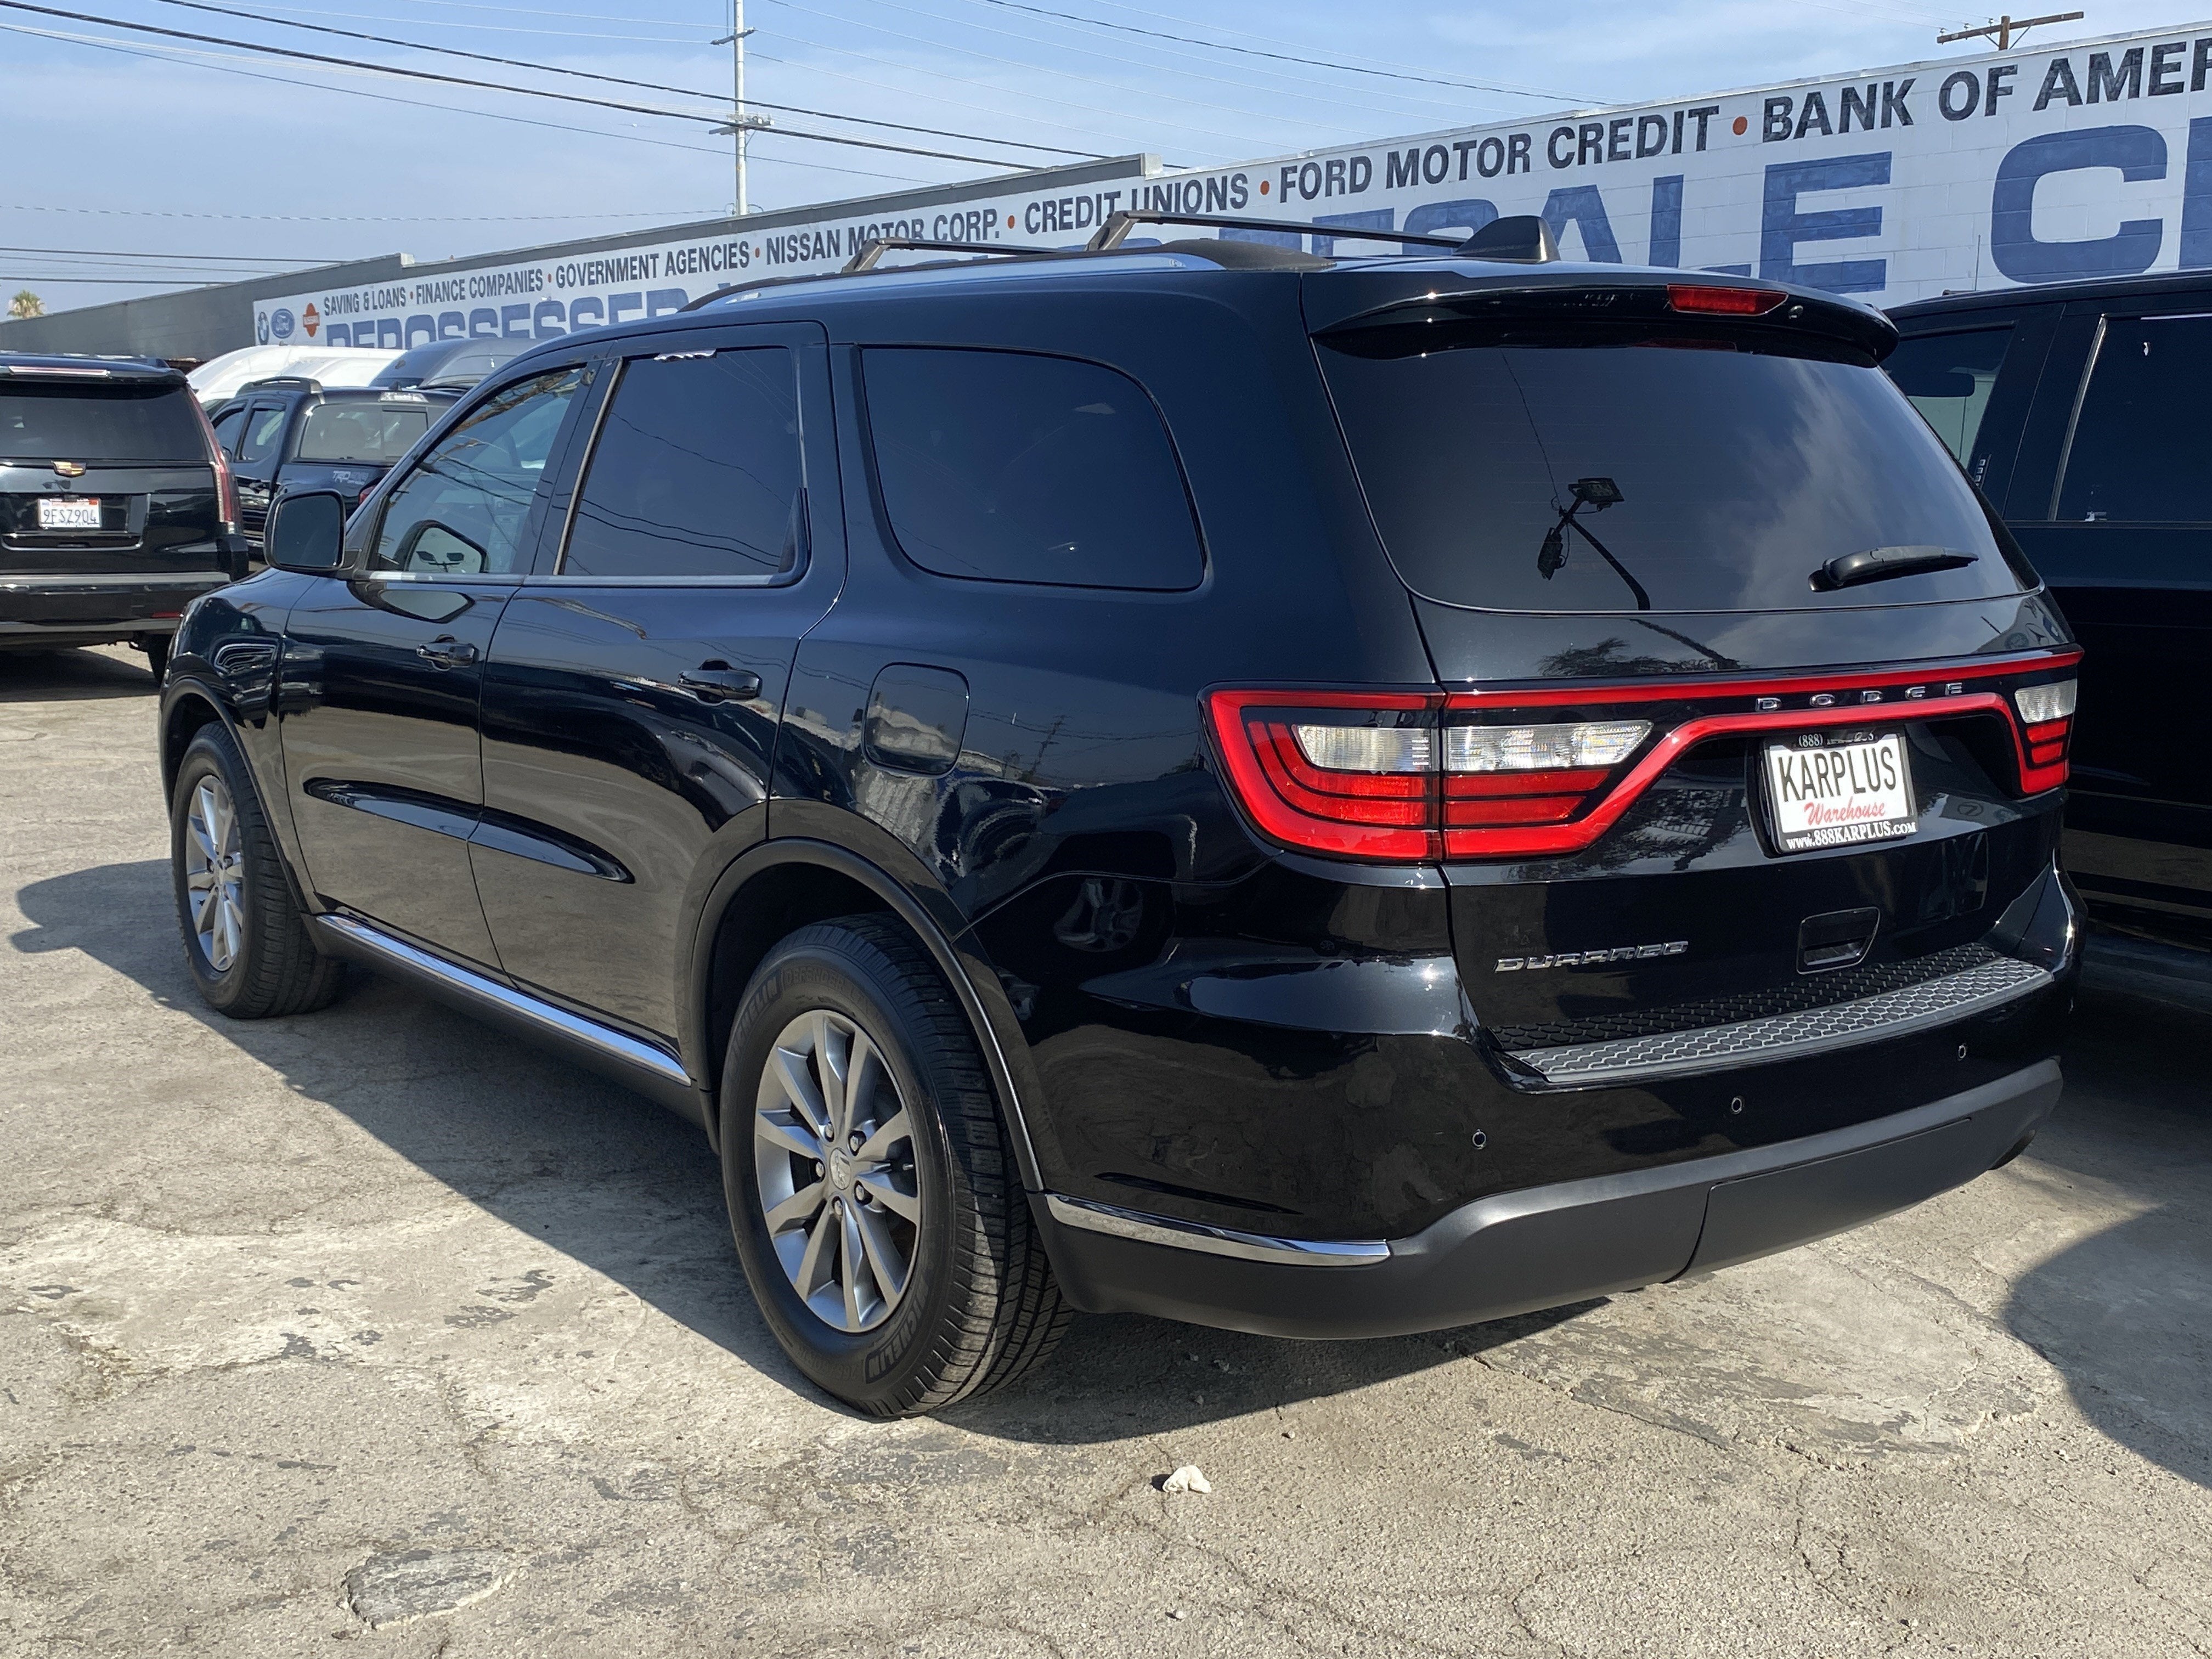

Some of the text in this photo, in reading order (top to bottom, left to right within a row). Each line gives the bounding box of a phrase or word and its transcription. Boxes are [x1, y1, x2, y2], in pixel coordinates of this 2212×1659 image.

[324, 290, 359, 316] SAVING
[363, 291, 369, 308] &
[372, 286, 406, 311] LOANS
[416, 279, 466, 305] FINANCE
[470, 268, 543, 298] COMPANIES
[556, 253, 659, 289] GOVERNMENT
[665, 240, 750, 277] AGENCIES
[766, 229, 840, 265] NISSAN
[848, 218, 924, 256] MOTOR
[934, 208, 1000, 242] CORP.
[1025, 190, 1121, 235] CREDIT
[1131, 173, 1249, 214] UNIONS
[1280, 155, 1372, 204] FORD
[1386, 132, 1532, 190] MOTOR
[1547, 105, 1719, 169] CREDIT
[1763, 77, 1914, 143] BANK
[1938, 64, 2018, 121] OF
[1992, 116, 2212, 283] C
[1756, 682, 1963, 712] DODGE
[1798, 733, 1823, 748] (888)
[1778, 747, 1897, 802] KARPLUS
[1804, 797, 1886, 826] Warehouse
[1493, 940, 1689, 973] DURANGO
